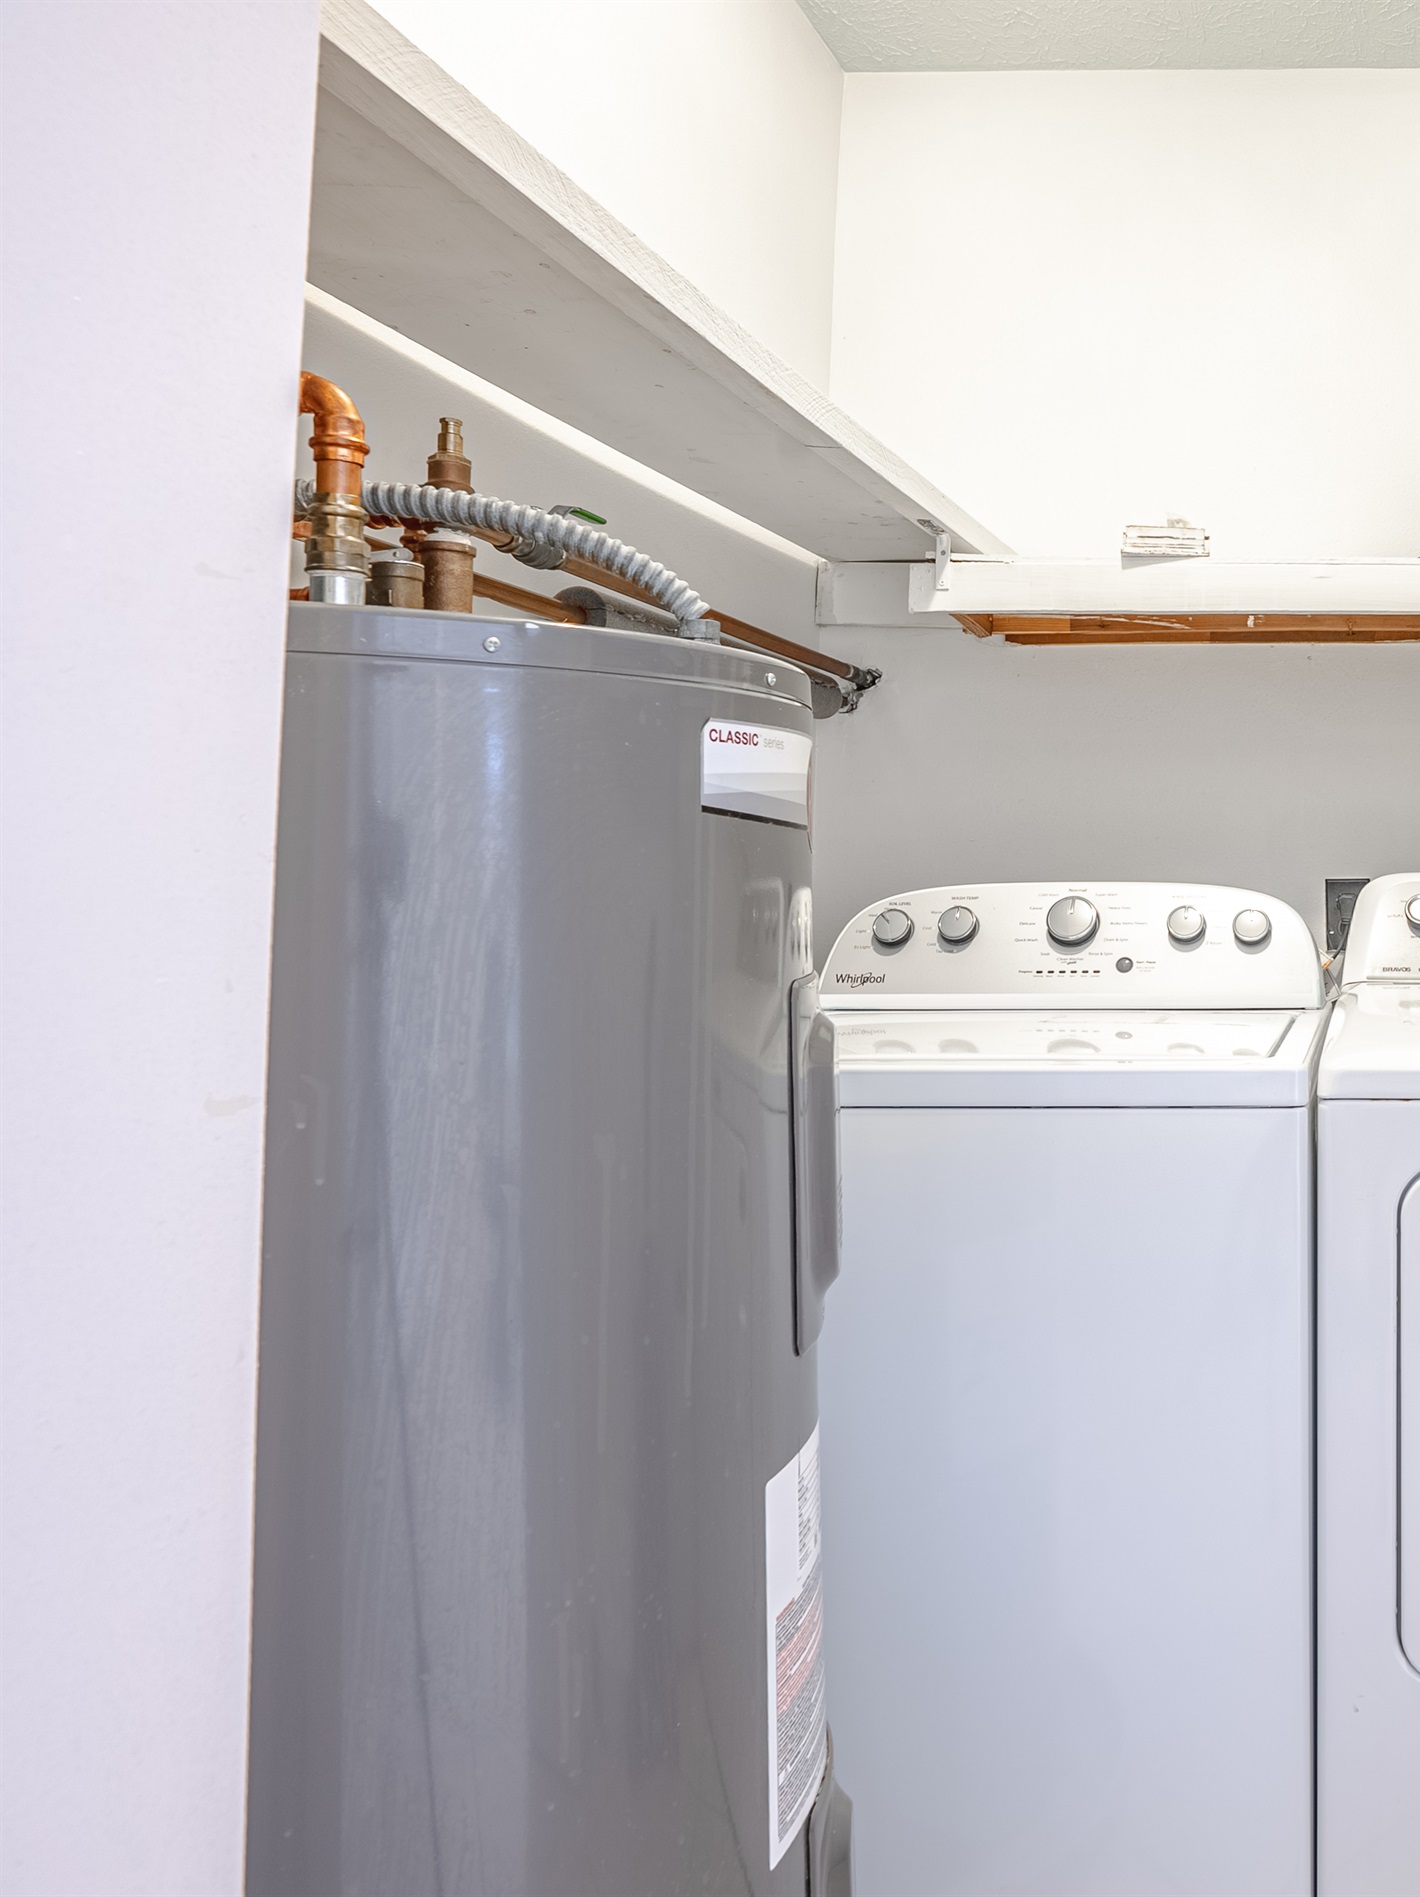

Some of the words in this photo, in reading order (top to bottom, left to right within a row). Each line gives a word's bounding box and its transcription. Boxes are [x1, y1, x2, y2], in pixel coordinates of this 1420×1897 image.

[709, 728, 759, 746] CLASSIC
[763, 737, 784, 750] series
[835, 972, 886, 988] Whirlpool
